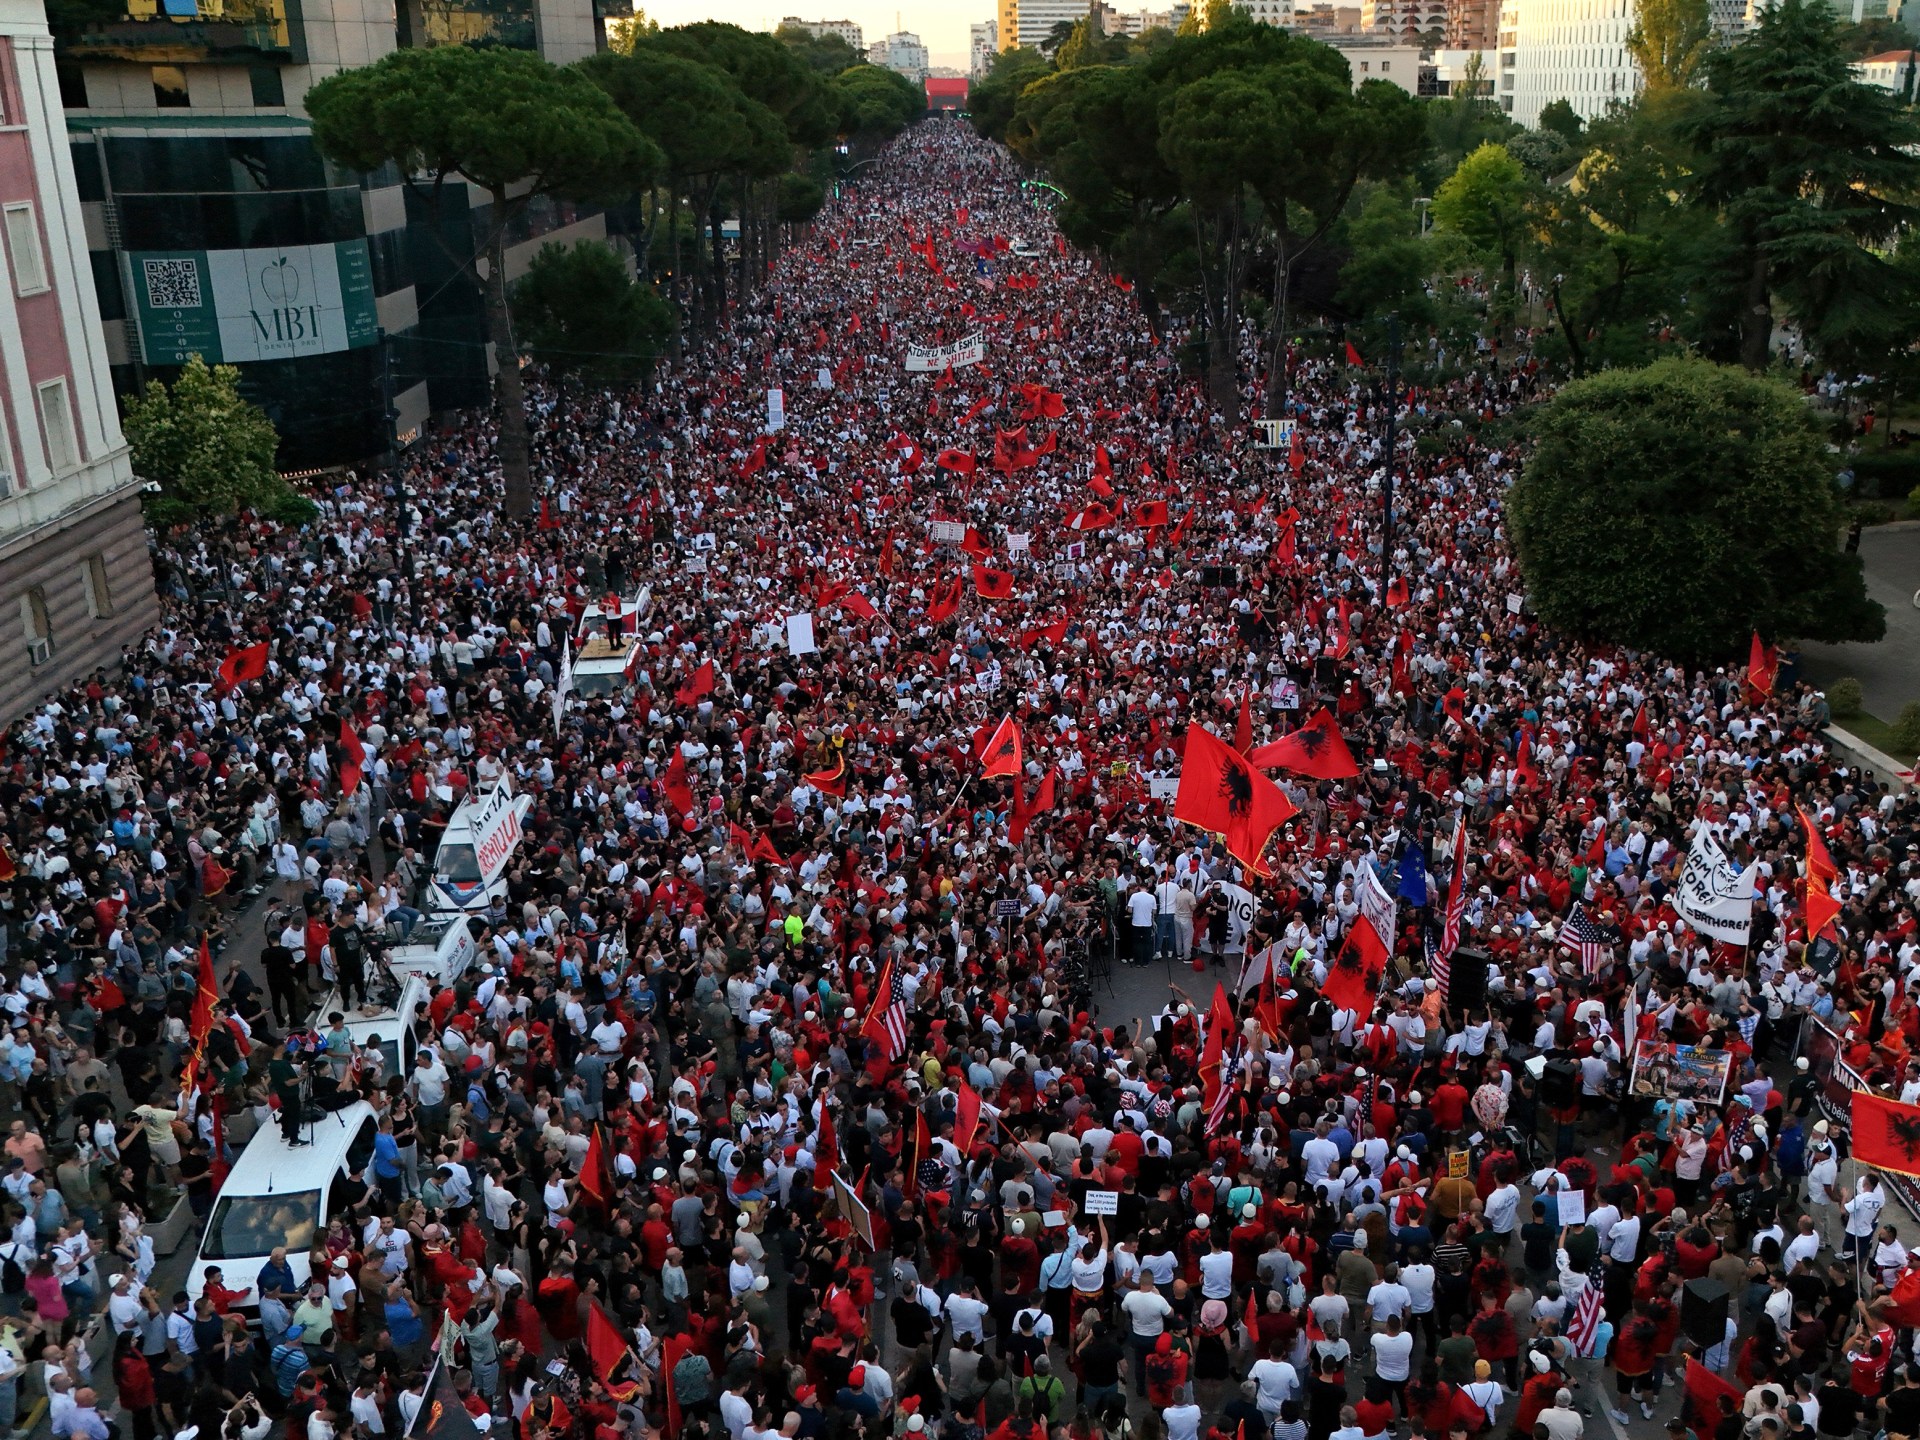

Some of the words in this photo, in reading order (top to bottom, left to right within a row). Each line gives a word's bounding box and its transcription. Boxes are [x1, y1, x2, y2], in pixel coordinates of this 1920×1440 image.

[249, 305, 321, 343] MBT
[941, 344, 957, 356] NUK
[946, 349, 976, 364] SHITJE
